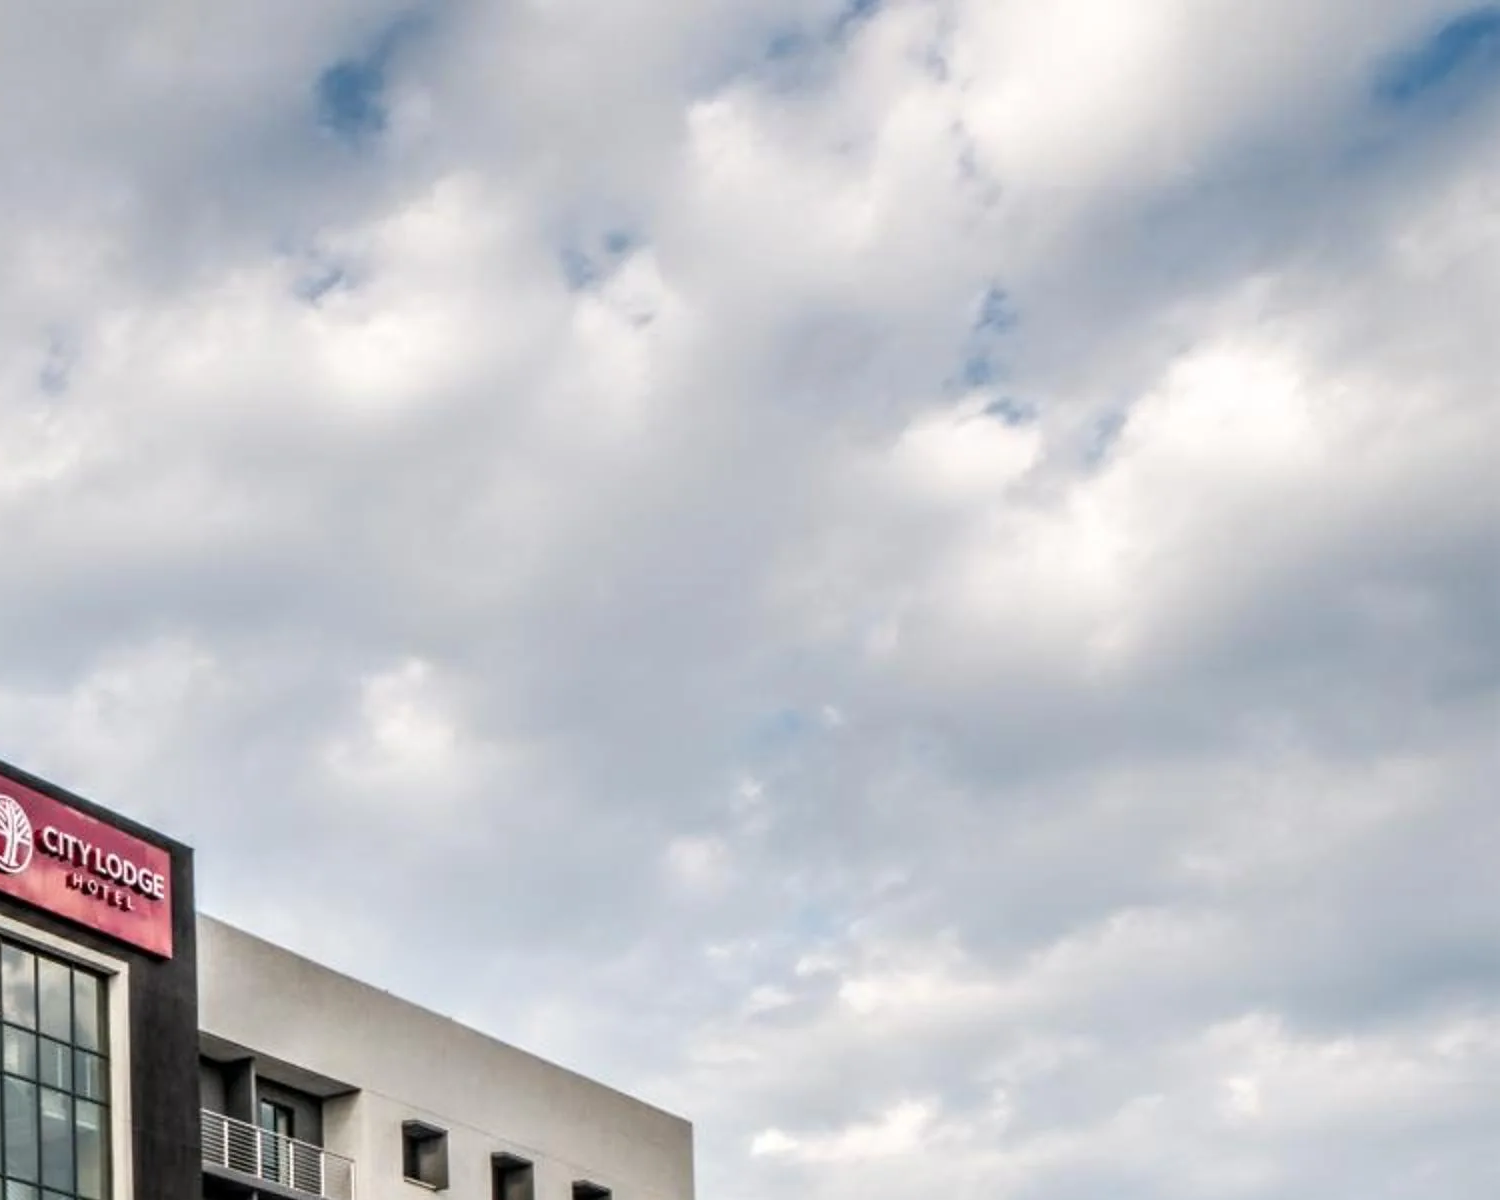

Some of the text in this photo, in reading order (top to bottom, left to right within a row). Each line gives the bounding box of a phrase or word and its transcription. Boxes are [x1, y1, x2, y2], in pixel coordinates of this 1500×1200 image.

[43, 826, 165, 899] CITY LODGE
[73, 875, 134, 909] HOTEL
